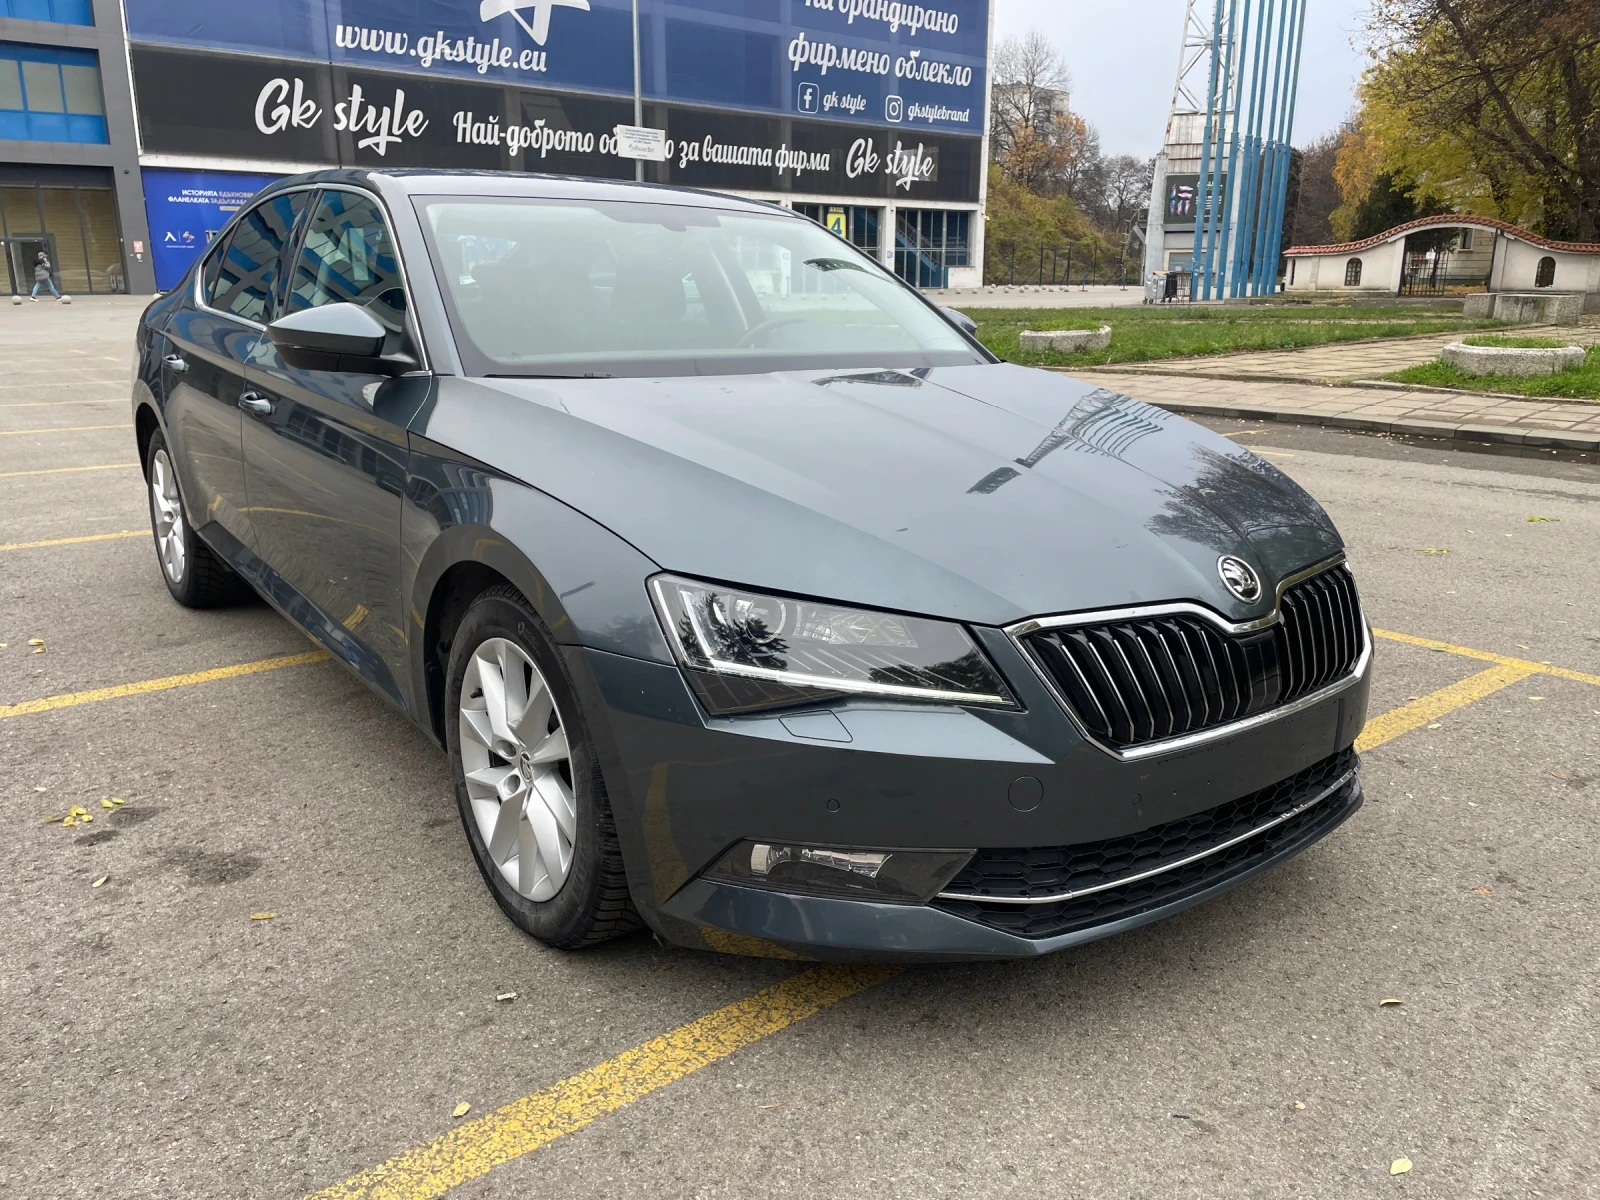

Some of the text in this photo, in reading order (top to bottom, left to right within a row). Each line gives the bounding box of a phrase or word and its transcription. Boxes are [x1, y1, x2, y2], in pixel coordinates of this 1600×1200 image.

[335, 24, 548, 75] www.gkstyle.eu
[788, 32, 972, 87] фирмено облекло
[254, 77, 430, 157] Gk style
[823, 91, 867, 115] gk style
[908, 102, 970, 123] gkstylebrand
[452, 110, 594, 159] Най-доброто
[678, 140, 700, 169] за
[702, 134, 773, 167] вашата
[775, 143, 831, 177] фирма
[846, 137, 936, 191] Gk style
[831, 217, 843, 235] 4
